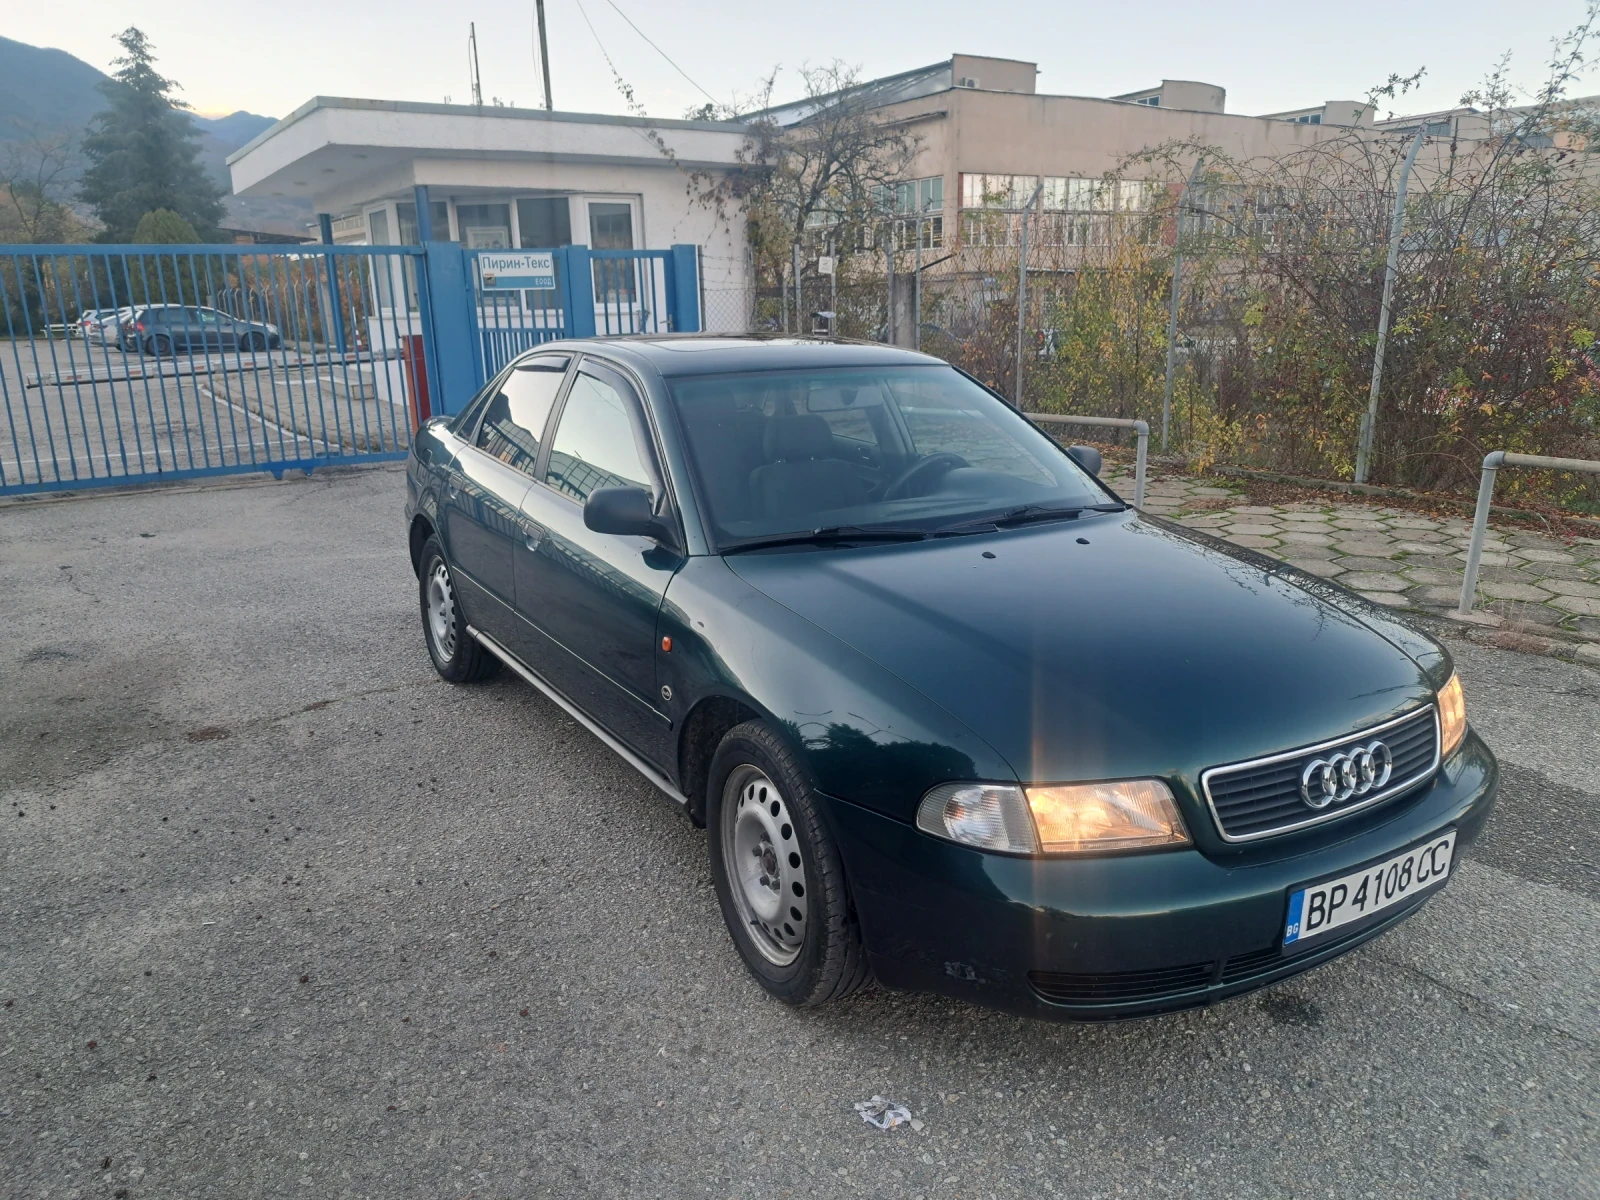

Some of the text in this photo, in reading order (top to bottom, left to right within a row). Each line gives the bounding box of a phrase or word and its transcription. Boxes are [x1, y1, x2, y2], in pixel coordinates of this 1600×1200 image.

[482, 256, 550, 272] Пирин-Текс
[535, 278, 552, 286] ЕООД
[1286, 922, 1299, 936] BG
